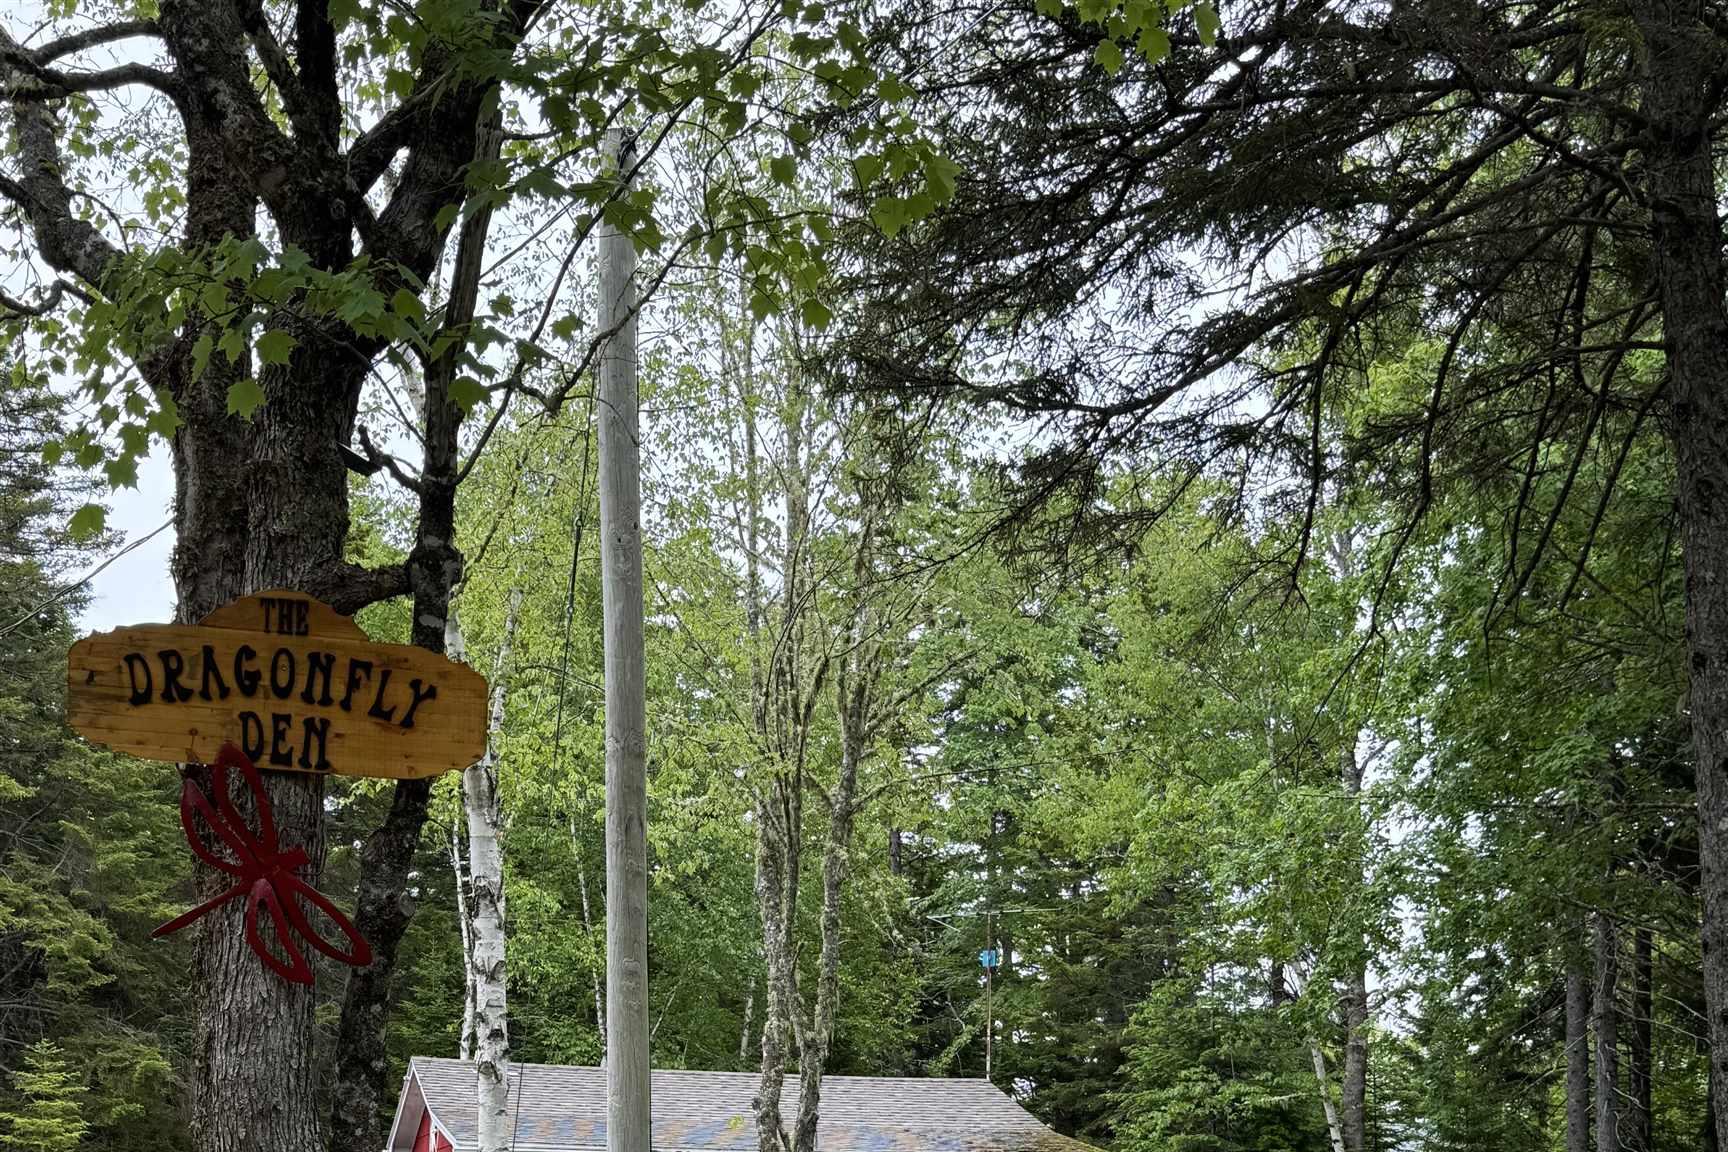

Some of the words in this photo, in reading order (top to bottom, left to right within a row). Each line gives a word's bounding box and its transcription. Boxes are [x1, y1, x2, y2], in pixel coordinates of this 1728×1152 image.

[260, 598, 310, 636] THE
[123, 644, 437, 729] DRAGONFLY
[239, 710, 331, 770] DEN
